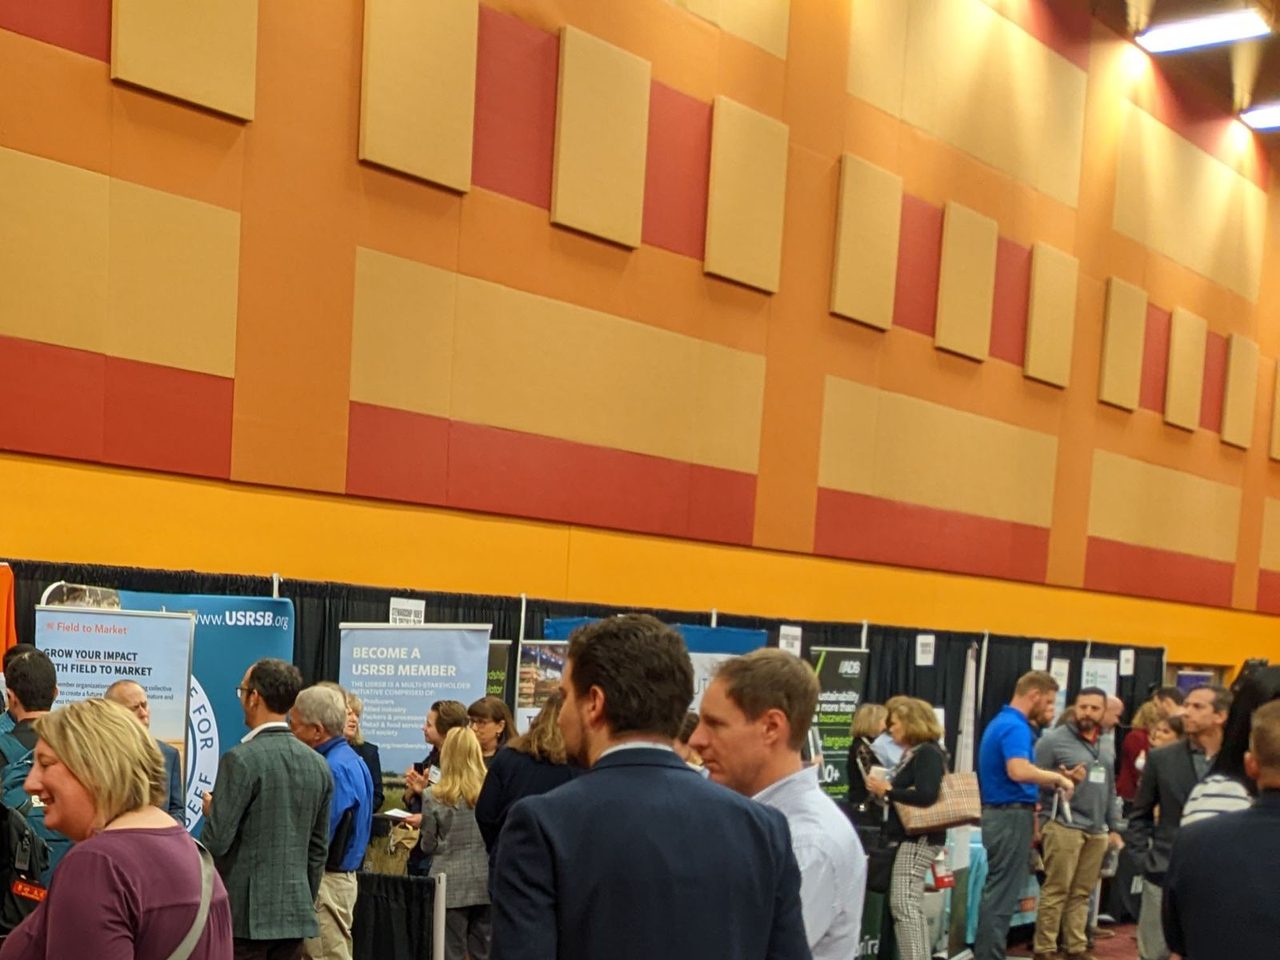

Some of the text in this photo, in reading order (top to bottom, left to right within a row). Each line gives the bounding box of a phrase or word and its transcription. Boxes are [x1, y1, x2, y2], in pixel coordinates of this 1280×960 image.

[57, 623, 128, 635] Field to Market
[44, 648, 138, 662] GROW YOUR IMPACT
[353, 647, 421, 659] BECOME A
[70, 664, 97, 674] FIELD
[99, 665, 113, 676] TO
[114, 666, 153, 677] MARKET
[352, 664, 456, 677] USRSB MEMBER
[193, 703, 214, 751] FOR
